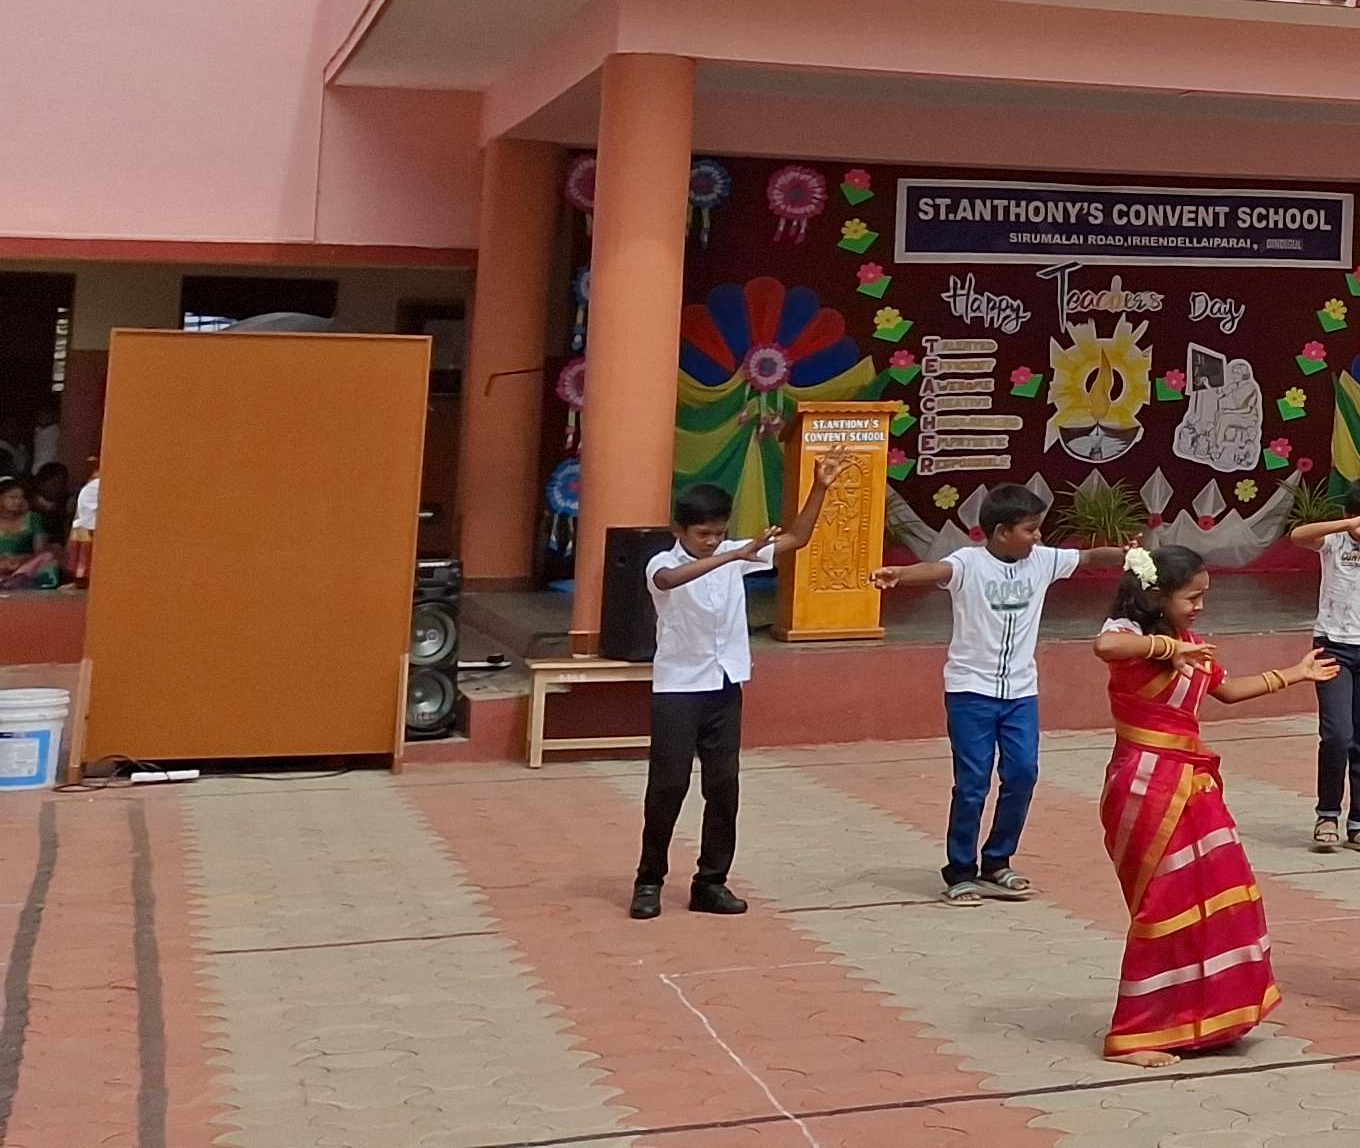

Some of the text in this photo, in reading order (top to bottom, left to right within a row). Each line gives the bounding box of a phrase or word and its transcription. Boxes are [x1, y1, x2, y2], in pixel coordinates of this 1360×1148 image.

[917, 197, 1332, 231] ST.ANTHONY'S CONVENT SCHOOL
[1008, 232, 1085, 245] SIRUMALAI
[942, 273, 1031, 333] Happy
[1189, 292, 1245, 334] Day
[804, 432, 886, 442] CONVENT SCHOOL
